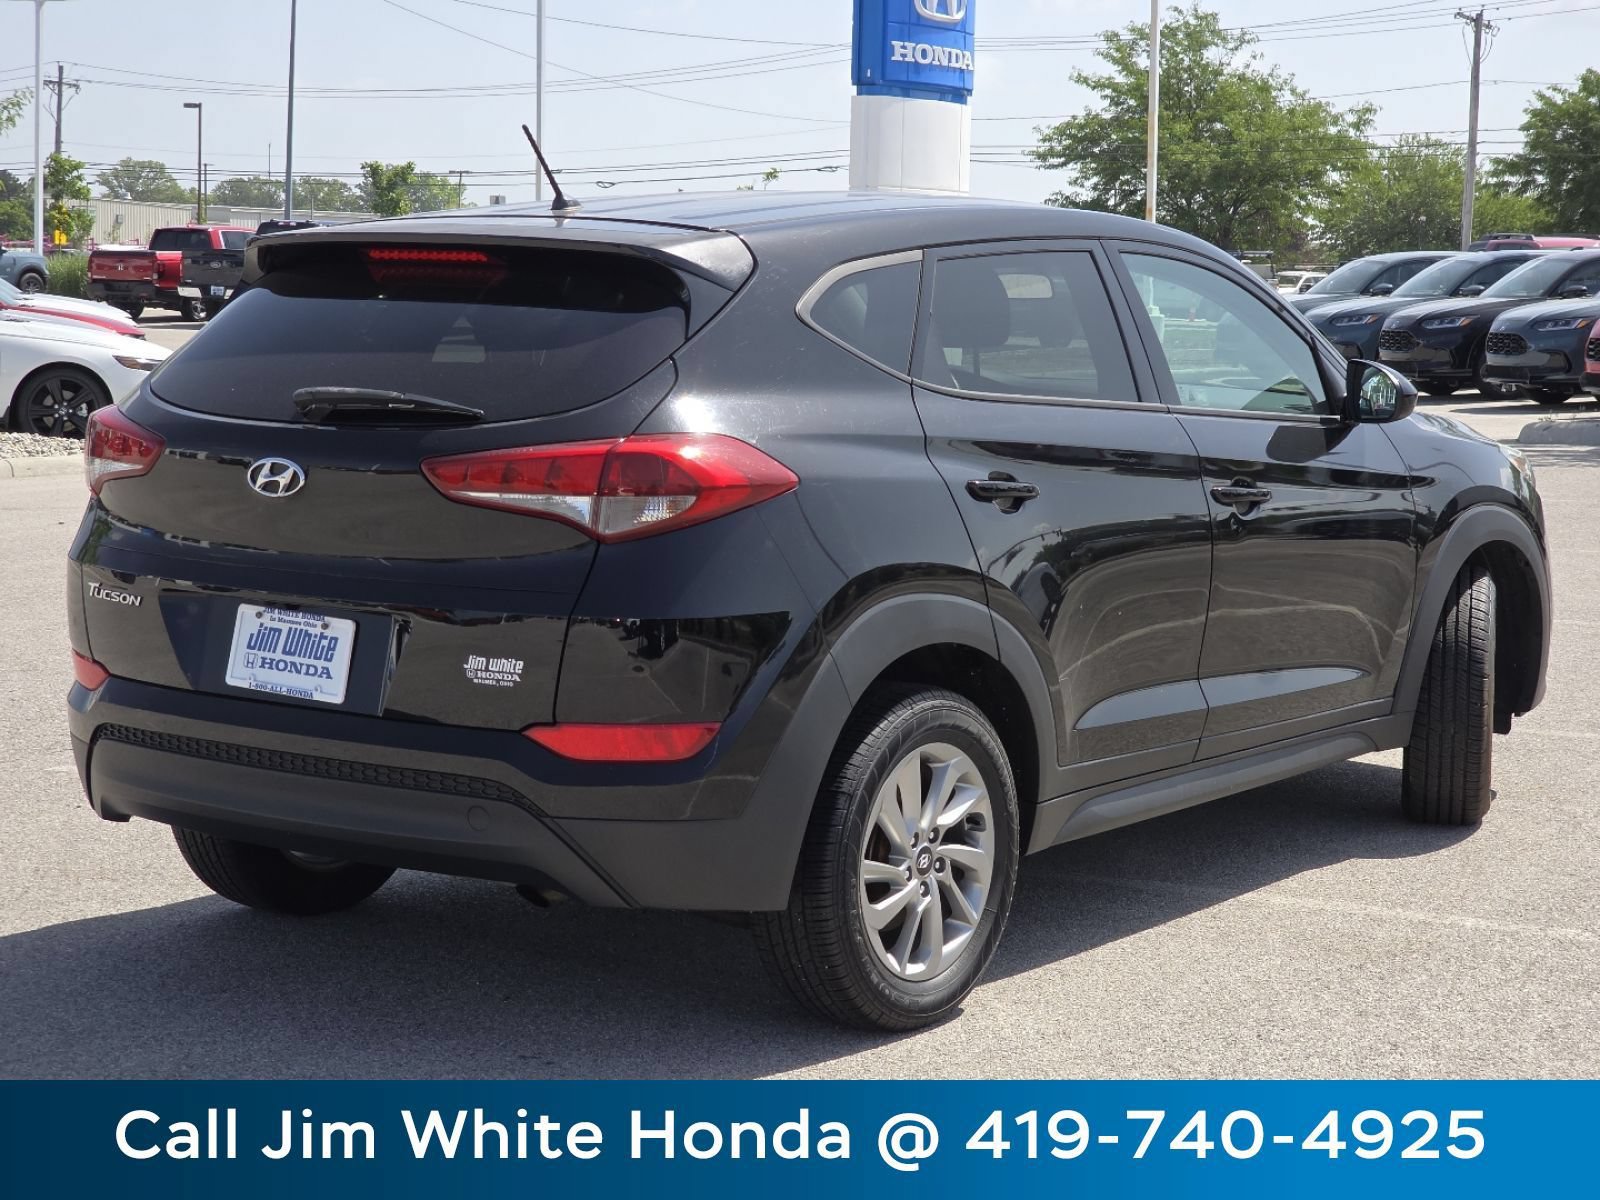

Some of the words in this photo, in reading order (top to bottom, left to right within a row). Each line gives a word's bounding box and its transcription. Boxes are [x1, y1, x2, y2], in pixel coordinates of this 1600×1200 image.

[891, 41, 974, 71] HONDA
[281, 627, 339, 662] White
[259, 657, 333, 680] HONDA
[477, 671, 521, 682] HONDA
